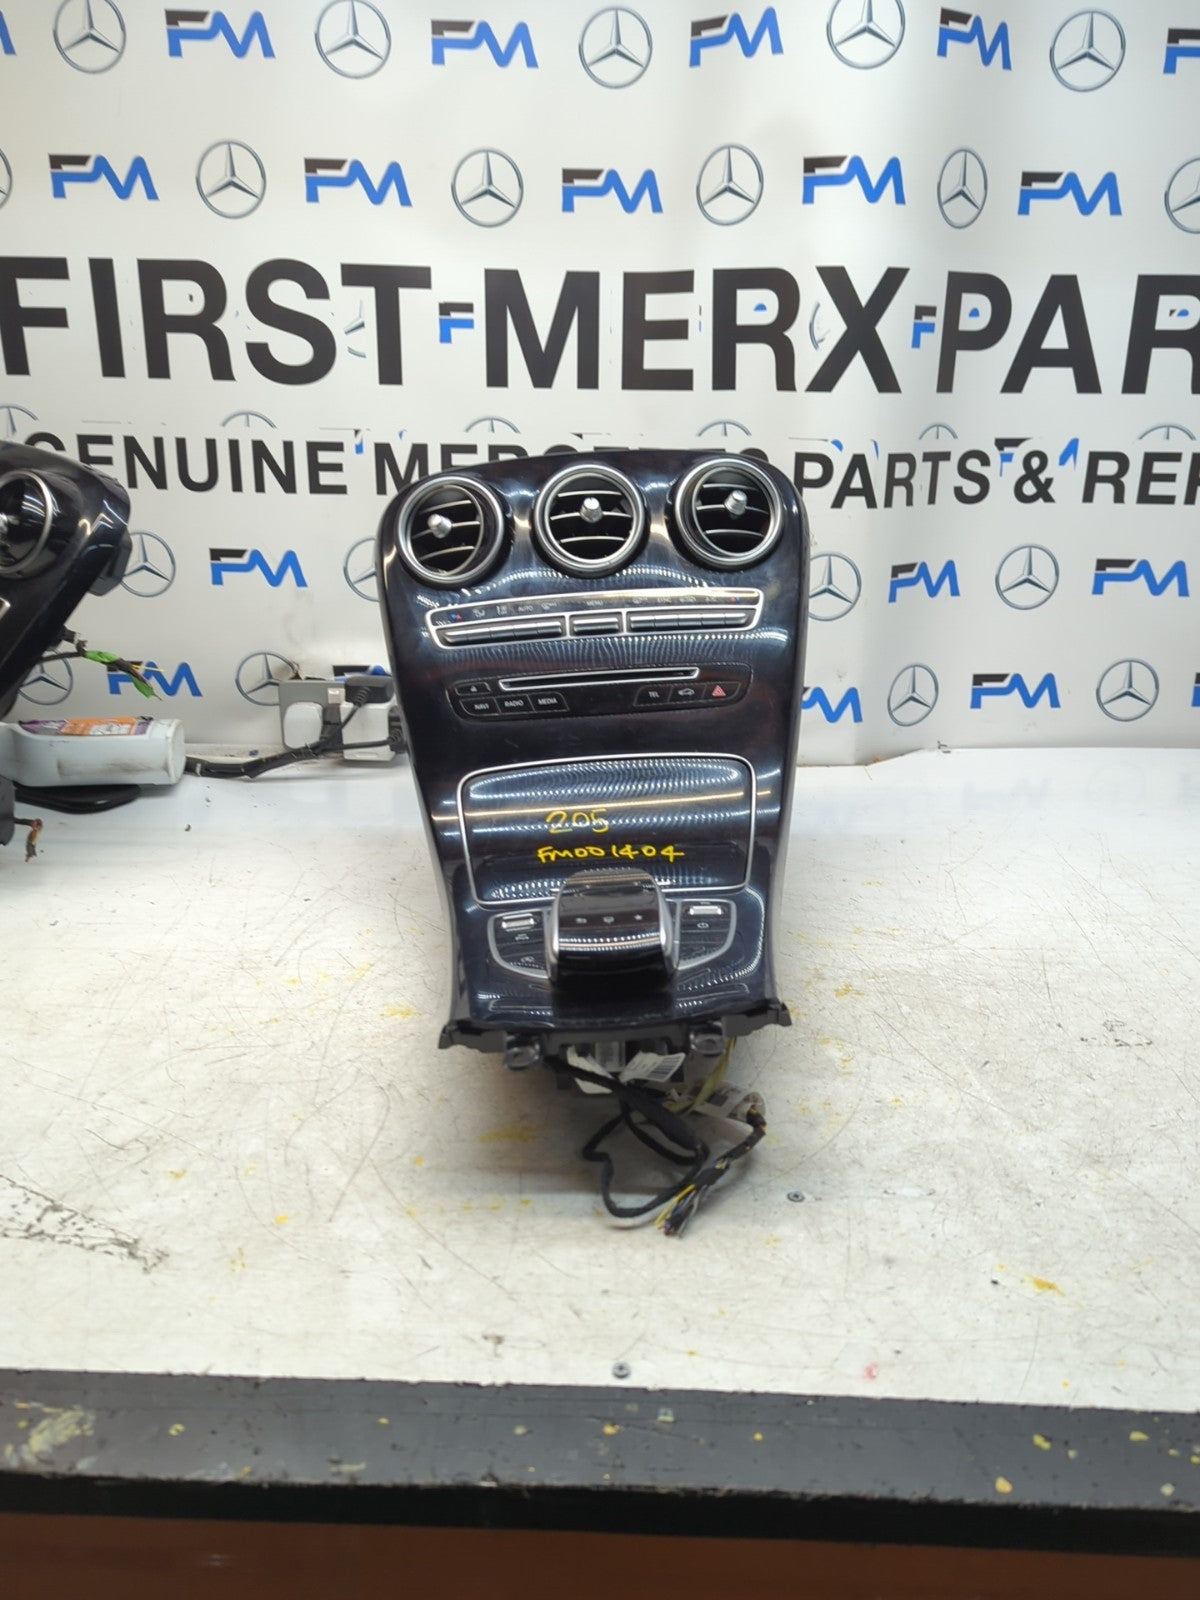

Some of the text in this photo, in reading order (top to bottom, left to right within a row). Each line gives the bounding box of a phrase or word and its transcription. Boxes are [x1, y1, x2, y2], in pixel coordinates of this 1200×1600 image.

[165, 9, 275, 58] FM
[431, 19, 538, 68] FM
[689, 6, 783, 68] FM
[937, 7, 1012, 70] FM
[48, 153, 159, 200] FM
[304, 157, 413, 207] FM
[562, 168, 663, 214] FM
[802, 155, 906, 205] FM
[1017, 171, 1122, 216] FM
[0, 256, 1200, 394] FIRST MERX PAR
[793, 449, 991, 509] PARTS
[1014, 450, 1056, 504] &
[209, 548, 307, 588] FM
[888, 560, 960, 603] FM
[1092, 558, 1190, 598] FM
[504, 699, 524, 707] RADIO
[537, 697, 558, 705] MEDIA
[802, 686, 863, 723] M
[970, 673, 1061, 709] FM
[546, 808, 609, 834] 205
